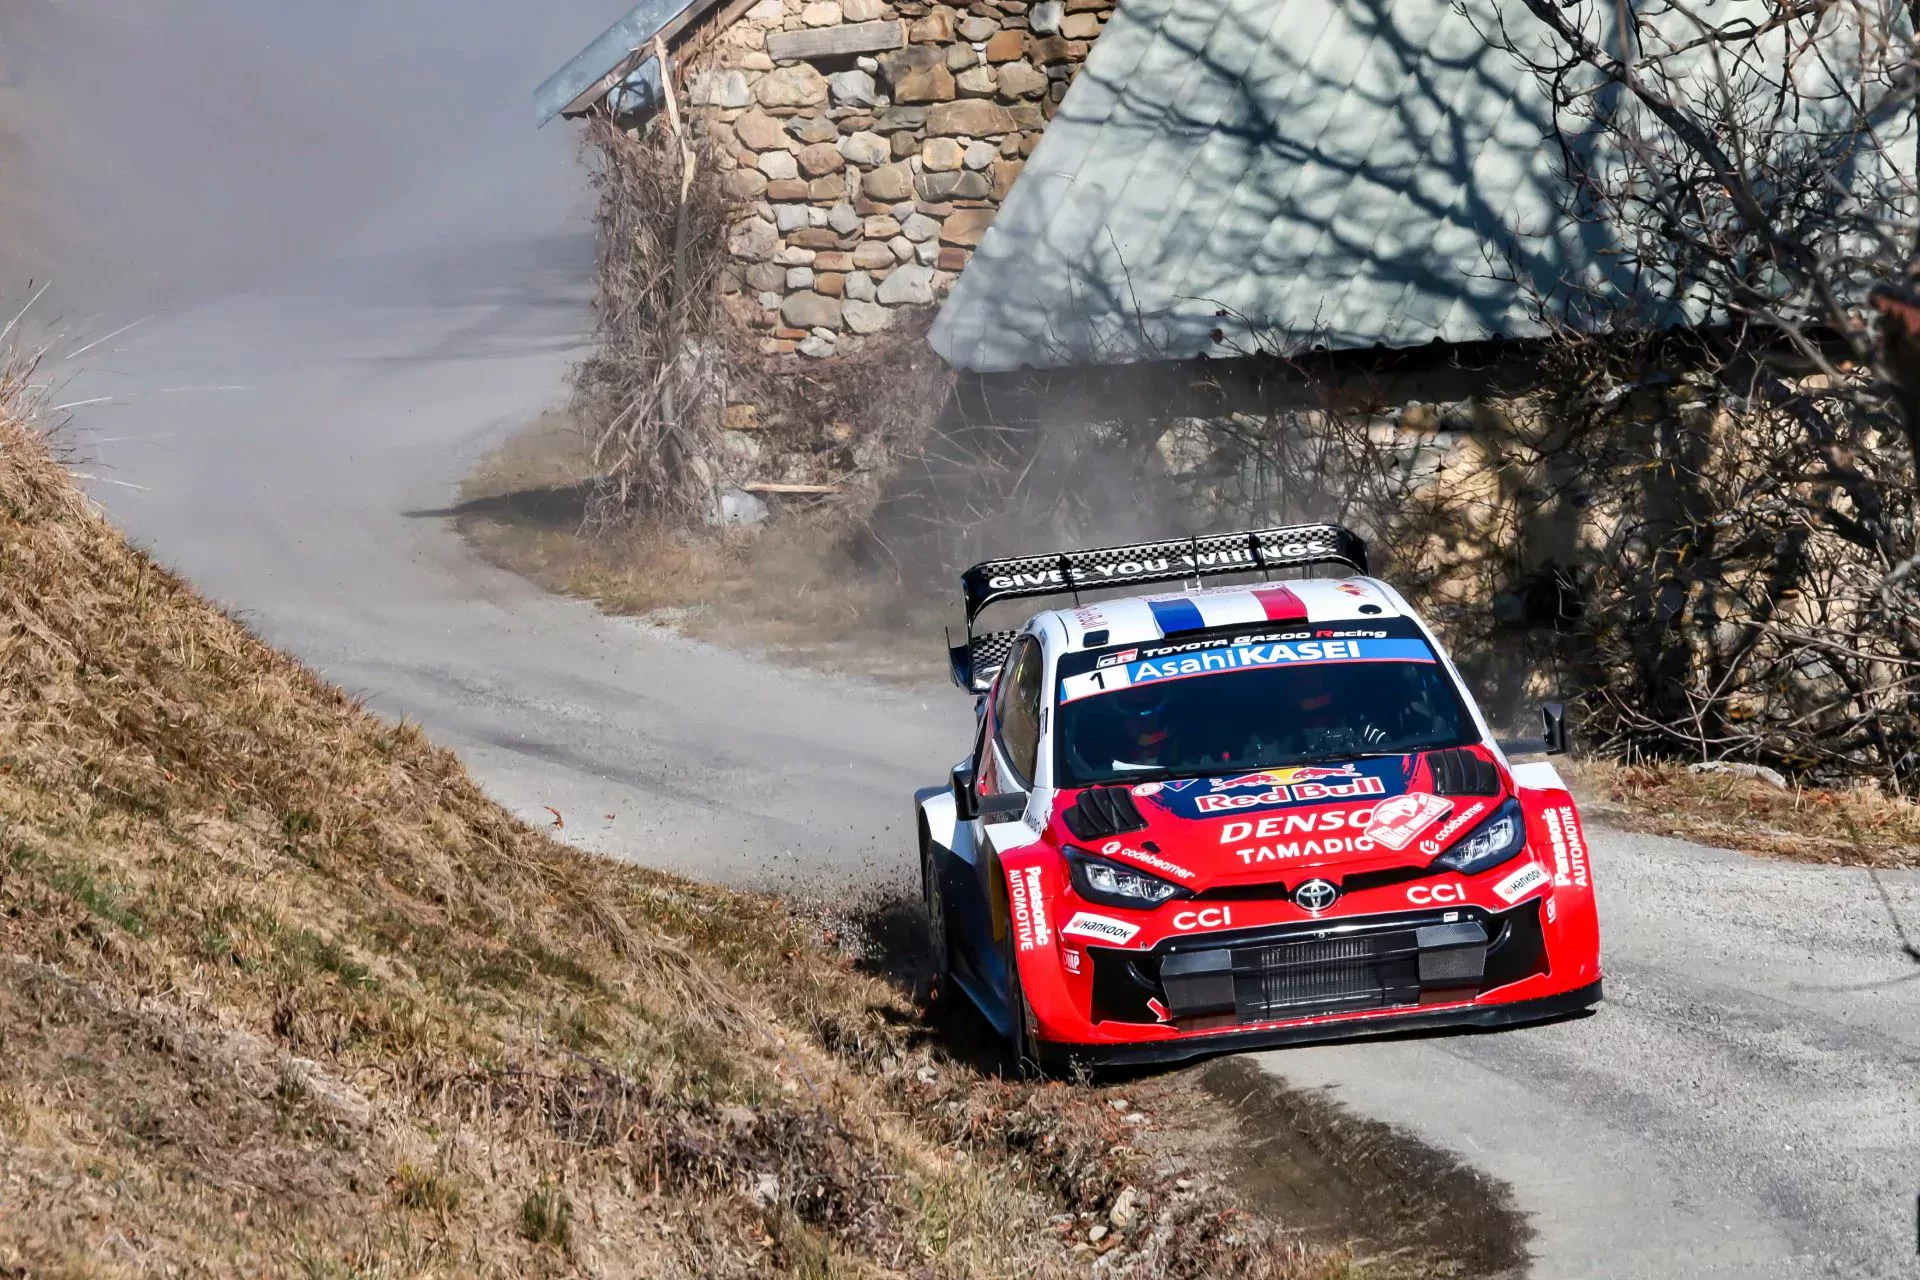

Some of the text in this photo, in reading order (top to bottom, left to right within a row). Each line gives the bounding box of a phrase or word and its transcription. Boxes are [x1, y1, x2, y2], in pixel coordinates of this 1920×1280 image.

[989, 567, 1085, 588] GIVES
[1095, 558, 1169, 577] YOU
[1100, 630, 1387, 668] GR TOYOTA GAZOO Racing
[1090, 672, 1105, 690] 1
[1195, 785, 1292, 812] Red
[1291, 776, 1386, 801] Bull
[1220, 808, 1374, 844] DENSO
[1434, 802, 1485, 842] codebeamer
[1121, 848, 1194, 880] codebeamer
[1236, 836, 1375, 865] TAMADIC
[1542, 808, 1572, 887] Panasonic
[1559, 805, 1588, 887] AUTOMOTIVE
[1009, 869, 1034, 952] AUTOMOTIVE
[1025, 866, 1051, 946] Panasonic
[1406, 883, 1466, 904] CCI
[1173, 906, 1231, 930] CCI
[1063, 952, 1080, 970] OMP
